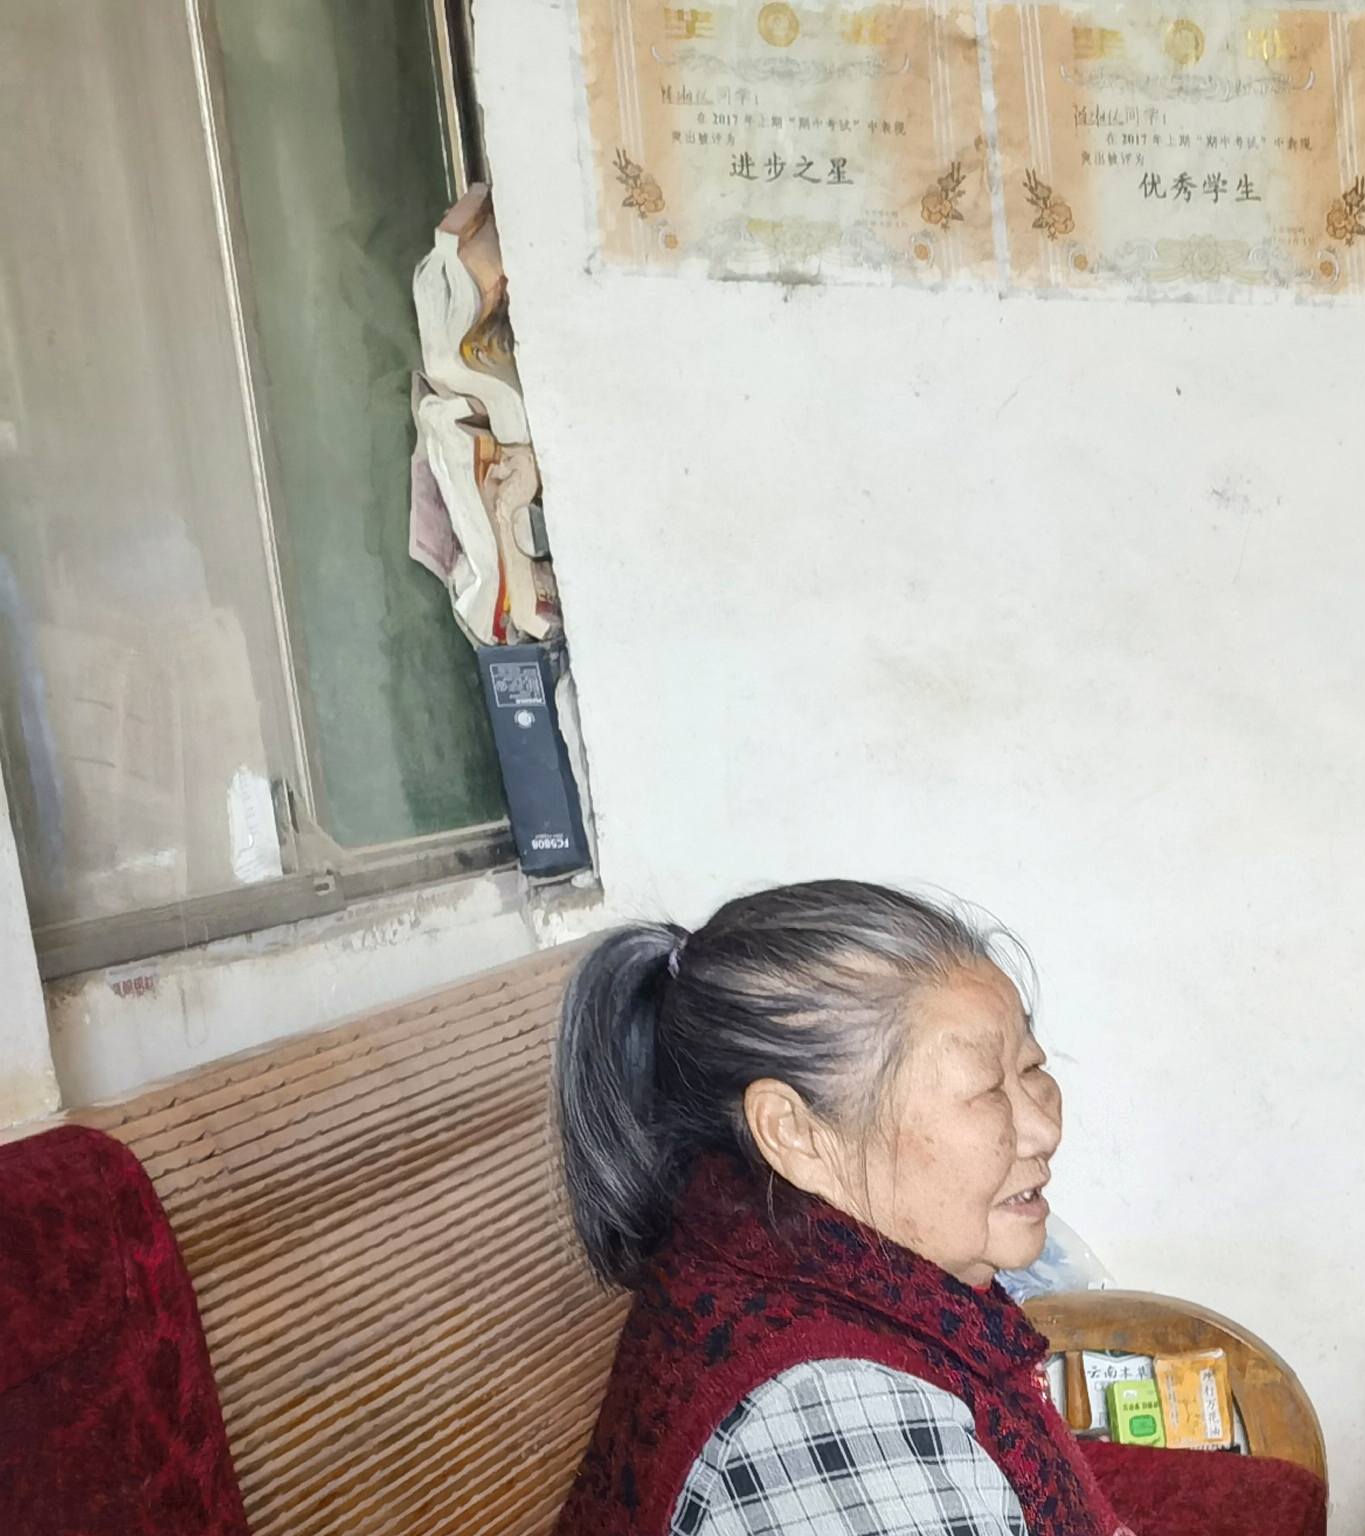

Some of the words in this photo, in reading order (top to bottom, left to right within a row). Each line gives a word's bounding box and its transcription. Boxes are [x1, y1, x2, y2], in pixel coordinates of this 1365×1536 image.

[729, 151, 854, 186] 进步之星
[1138, 172, 1262, 203] 优秀学生
